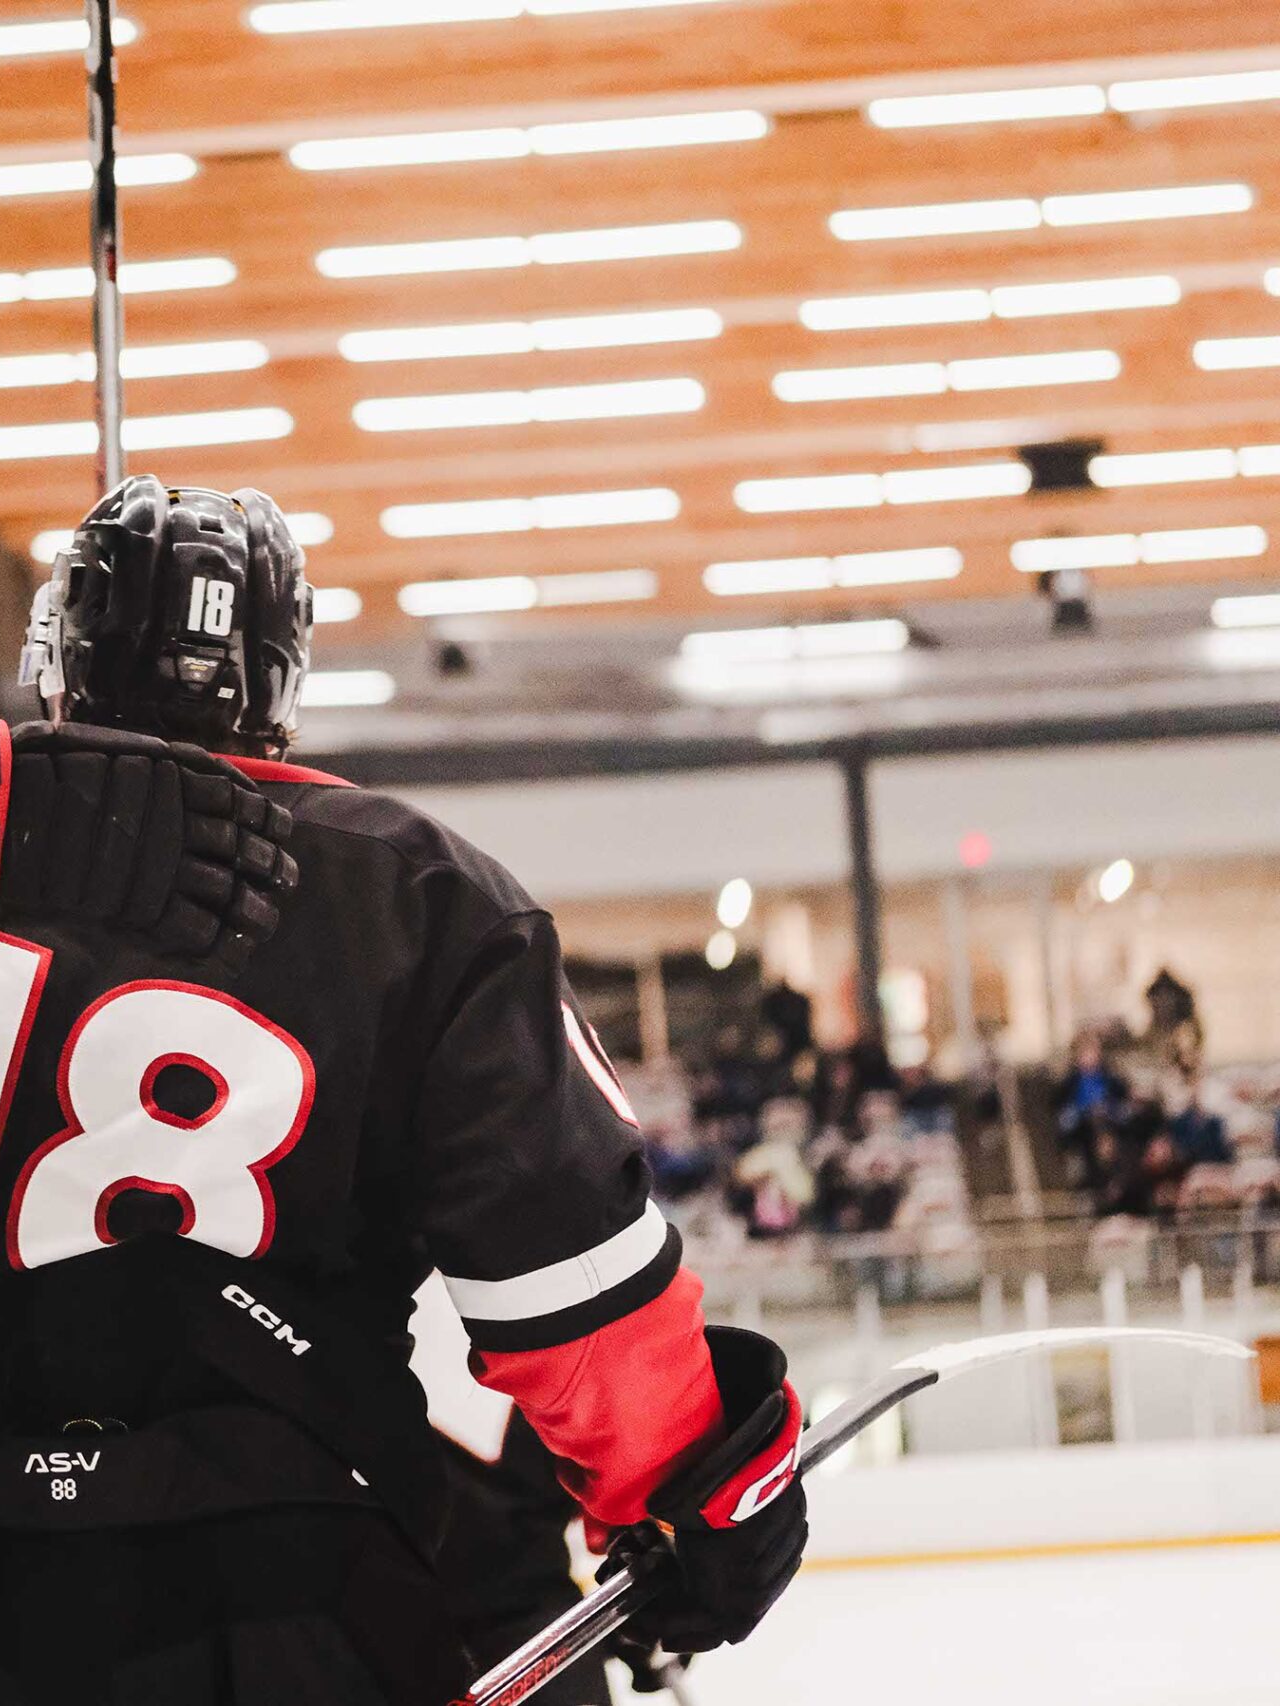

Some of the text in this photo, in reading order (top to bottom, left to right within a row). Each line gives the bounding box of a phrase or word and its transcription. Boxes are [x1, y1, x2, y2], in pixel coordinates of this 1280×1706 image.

[186, 576, 235, 637] 18
[221, 1284, 312, 1356] CCM
[24, 1451, 101, 1474] AS-V
[50, 1478, 78, 1501] 88
